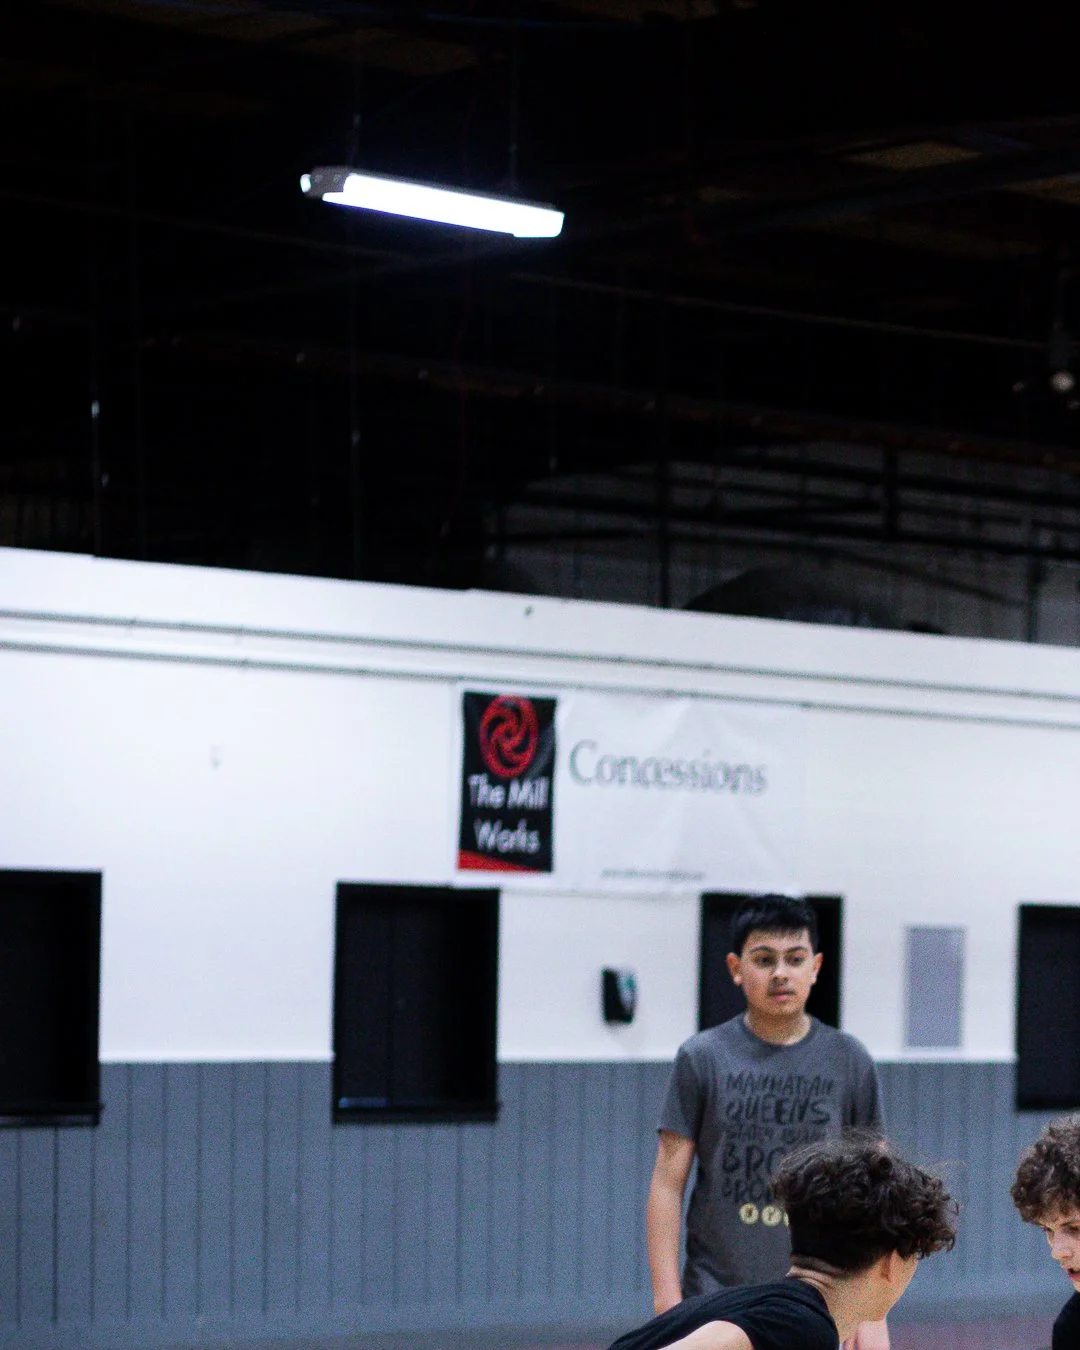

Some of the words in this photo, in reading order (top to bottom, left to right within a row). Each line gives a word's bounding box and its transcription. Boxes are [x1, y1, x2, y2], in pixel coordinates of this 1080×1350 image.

[569, 739, 769, 796] Concessions
[468, 774, 506, 809] The
[507, 776, 550, 810] Mill
[473, 819, 541, 852] Works
[725, 1094, 831, 1125] QUEENS
